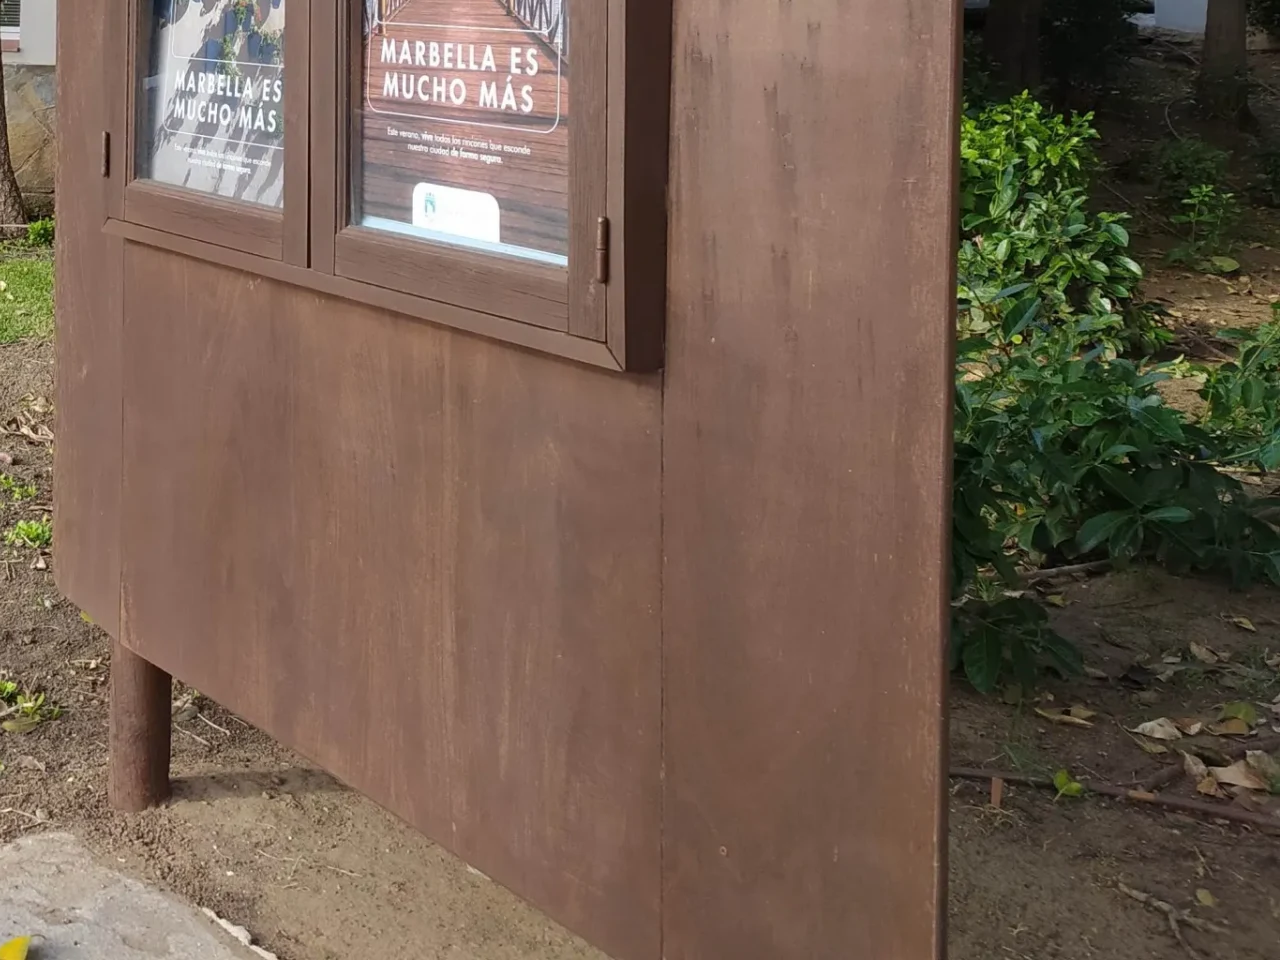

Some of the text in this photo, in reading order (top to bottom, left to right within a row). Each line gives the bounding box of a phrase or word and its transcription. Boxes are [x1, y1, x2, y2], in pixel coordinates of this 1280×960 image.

[381, 37, 539, 76] MARBELLA ES
[174, 69, 283, 103] MARBELLA ES
[383, 71, 534, 113] MUCHO MÁS
[173, 96, 277, 133] MUCHO MÁS
[387, 126, 399, 136] Este
[421, 131, 434, 142] vive
[451, 134, 461, 145] los
[462, 135, 489, 149] rincones
[489, 142, 502, 151] que
[503, 144, 531, 155] esconde
[450, 146, 459, 157] de
[479, 153, 504, 165] segura.
